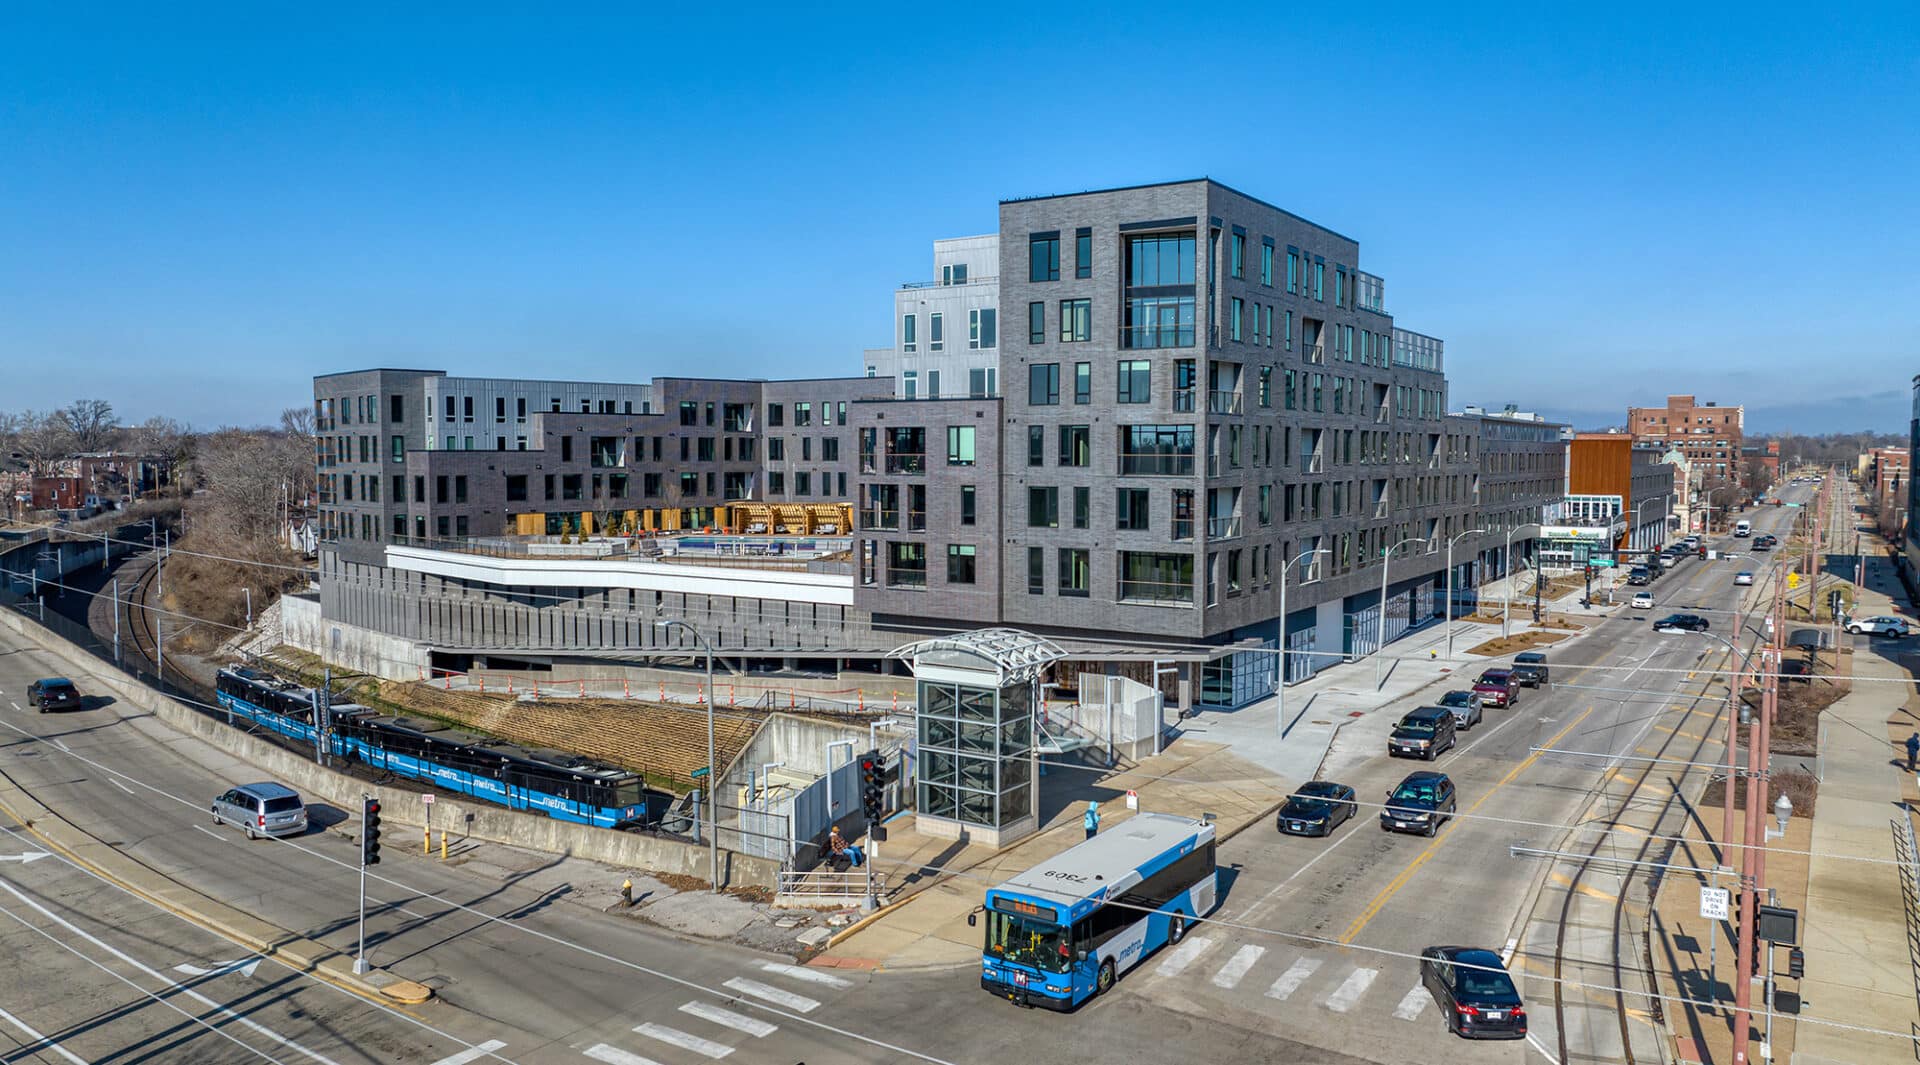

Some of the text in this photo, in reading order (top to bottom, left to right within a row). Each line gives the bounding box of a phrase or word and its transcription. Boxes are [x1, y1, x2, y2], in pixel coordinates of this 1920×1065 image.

[438, 768, 458, 780] metro
[543, 796, 567, 811] metro
[1044, 870, 1088, 884] 7309
[1118, 939, 1143, 961] metro
